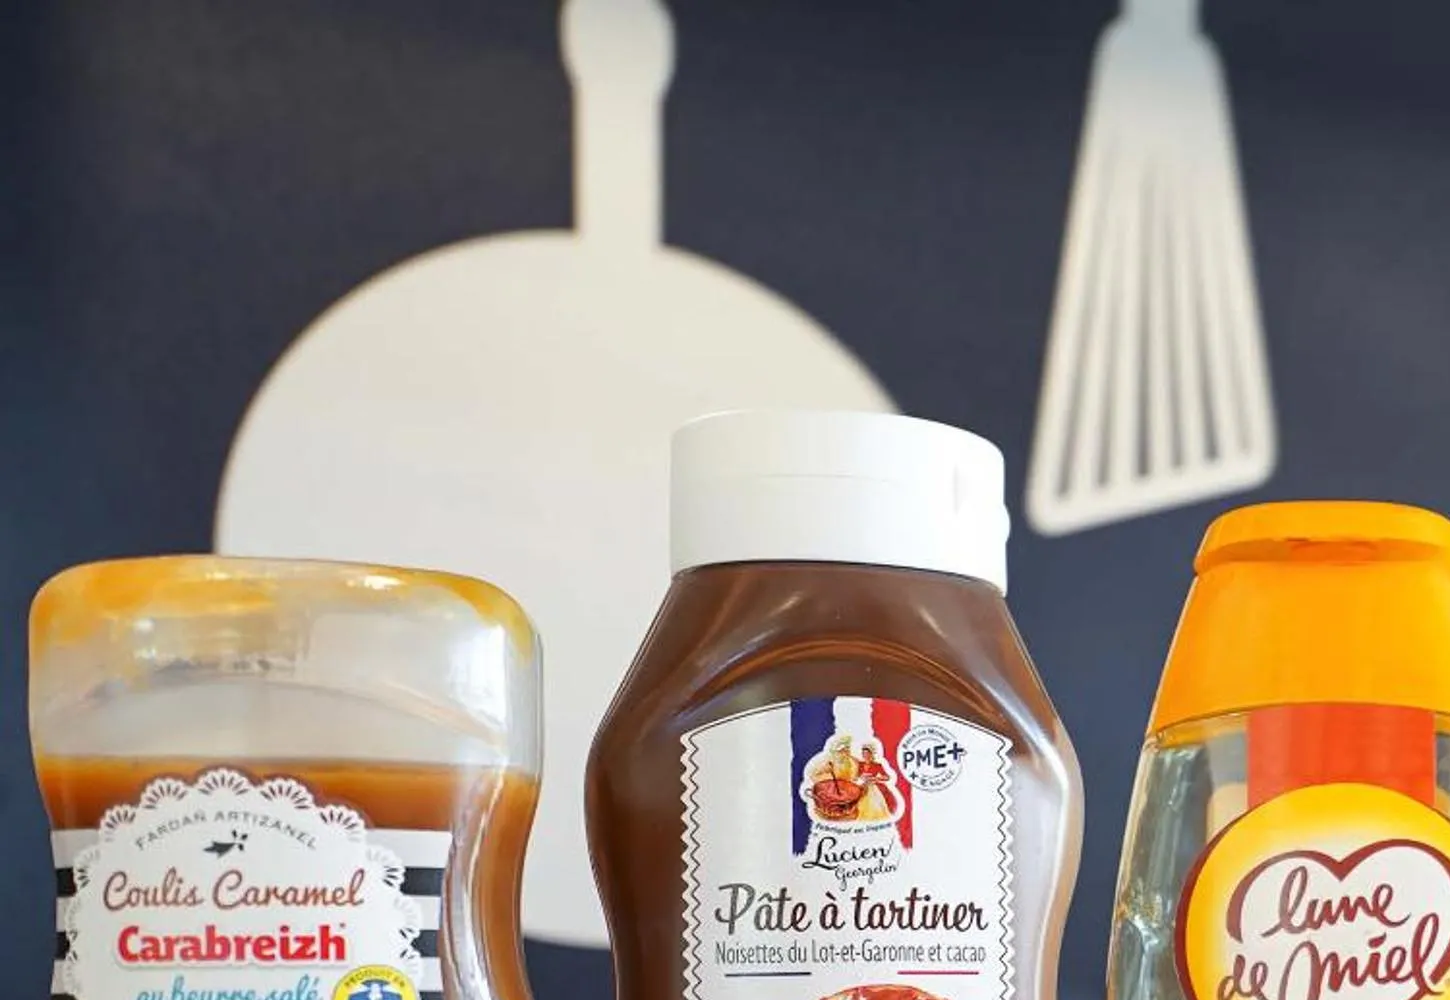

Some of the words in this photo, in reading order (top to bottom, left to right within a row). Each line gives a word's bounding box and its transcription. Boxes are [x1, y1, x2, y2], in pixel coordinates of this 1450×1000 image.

[135, 812, 206, 851] FARDAN
[214, 811, 316, 851] ARTIZANEL
[802, 836, 894, 870] Lucien
[103, 867, 205, 911] Coulis
[213, 868, 366, 910] Caramel
[715, 883, 811, 935] Pâte
[819, 891, 845, 931] à
[851, 887, 988, 931] tartiner
[118, 924, 345, 962] Carabreizh
[716, 941, 783, 964] Noisettes
[788, 940, 807, 962] du
[812, 939, 926, 962] Lot-et-Garonne
[928, 942, 942, 961] et
[946, 943, 986, 962] cacao
